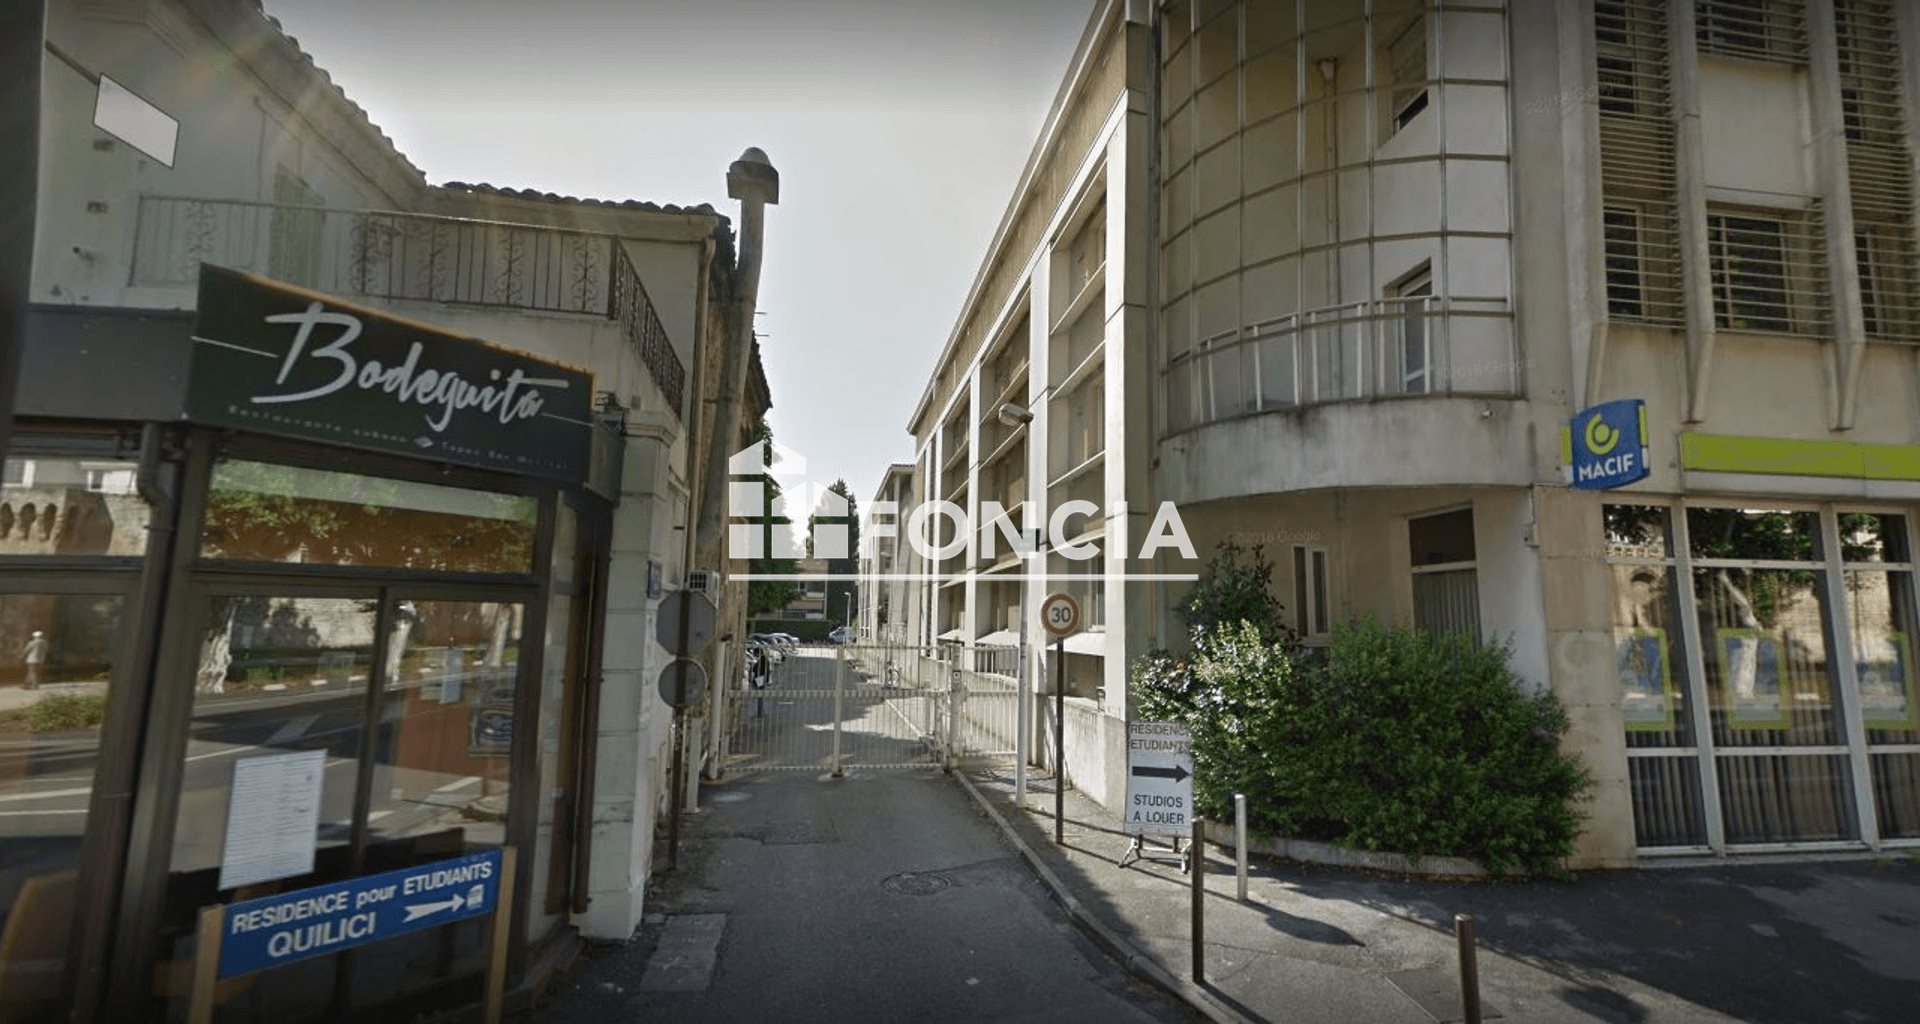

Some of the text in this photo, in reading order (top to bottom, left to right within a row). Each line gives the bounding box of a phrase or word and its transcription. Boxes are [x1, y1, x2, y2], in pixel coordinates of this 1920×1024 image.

[250, 300, 569, 432] Bodeguita
[1578, 453, 1634, 482] MACIF
[1051, 606, 1072, 623] 30
[1130, 739, 1191, 751] ETUDIANTS
[1134, 794, 1183, 808] STUDIOS
[1133, 810, 1185, 824] A LOUER
[231, 861, 493, 935] RESIDENCE pour ETUDIANTS
[267, 911, 377, 957] QUILICI
